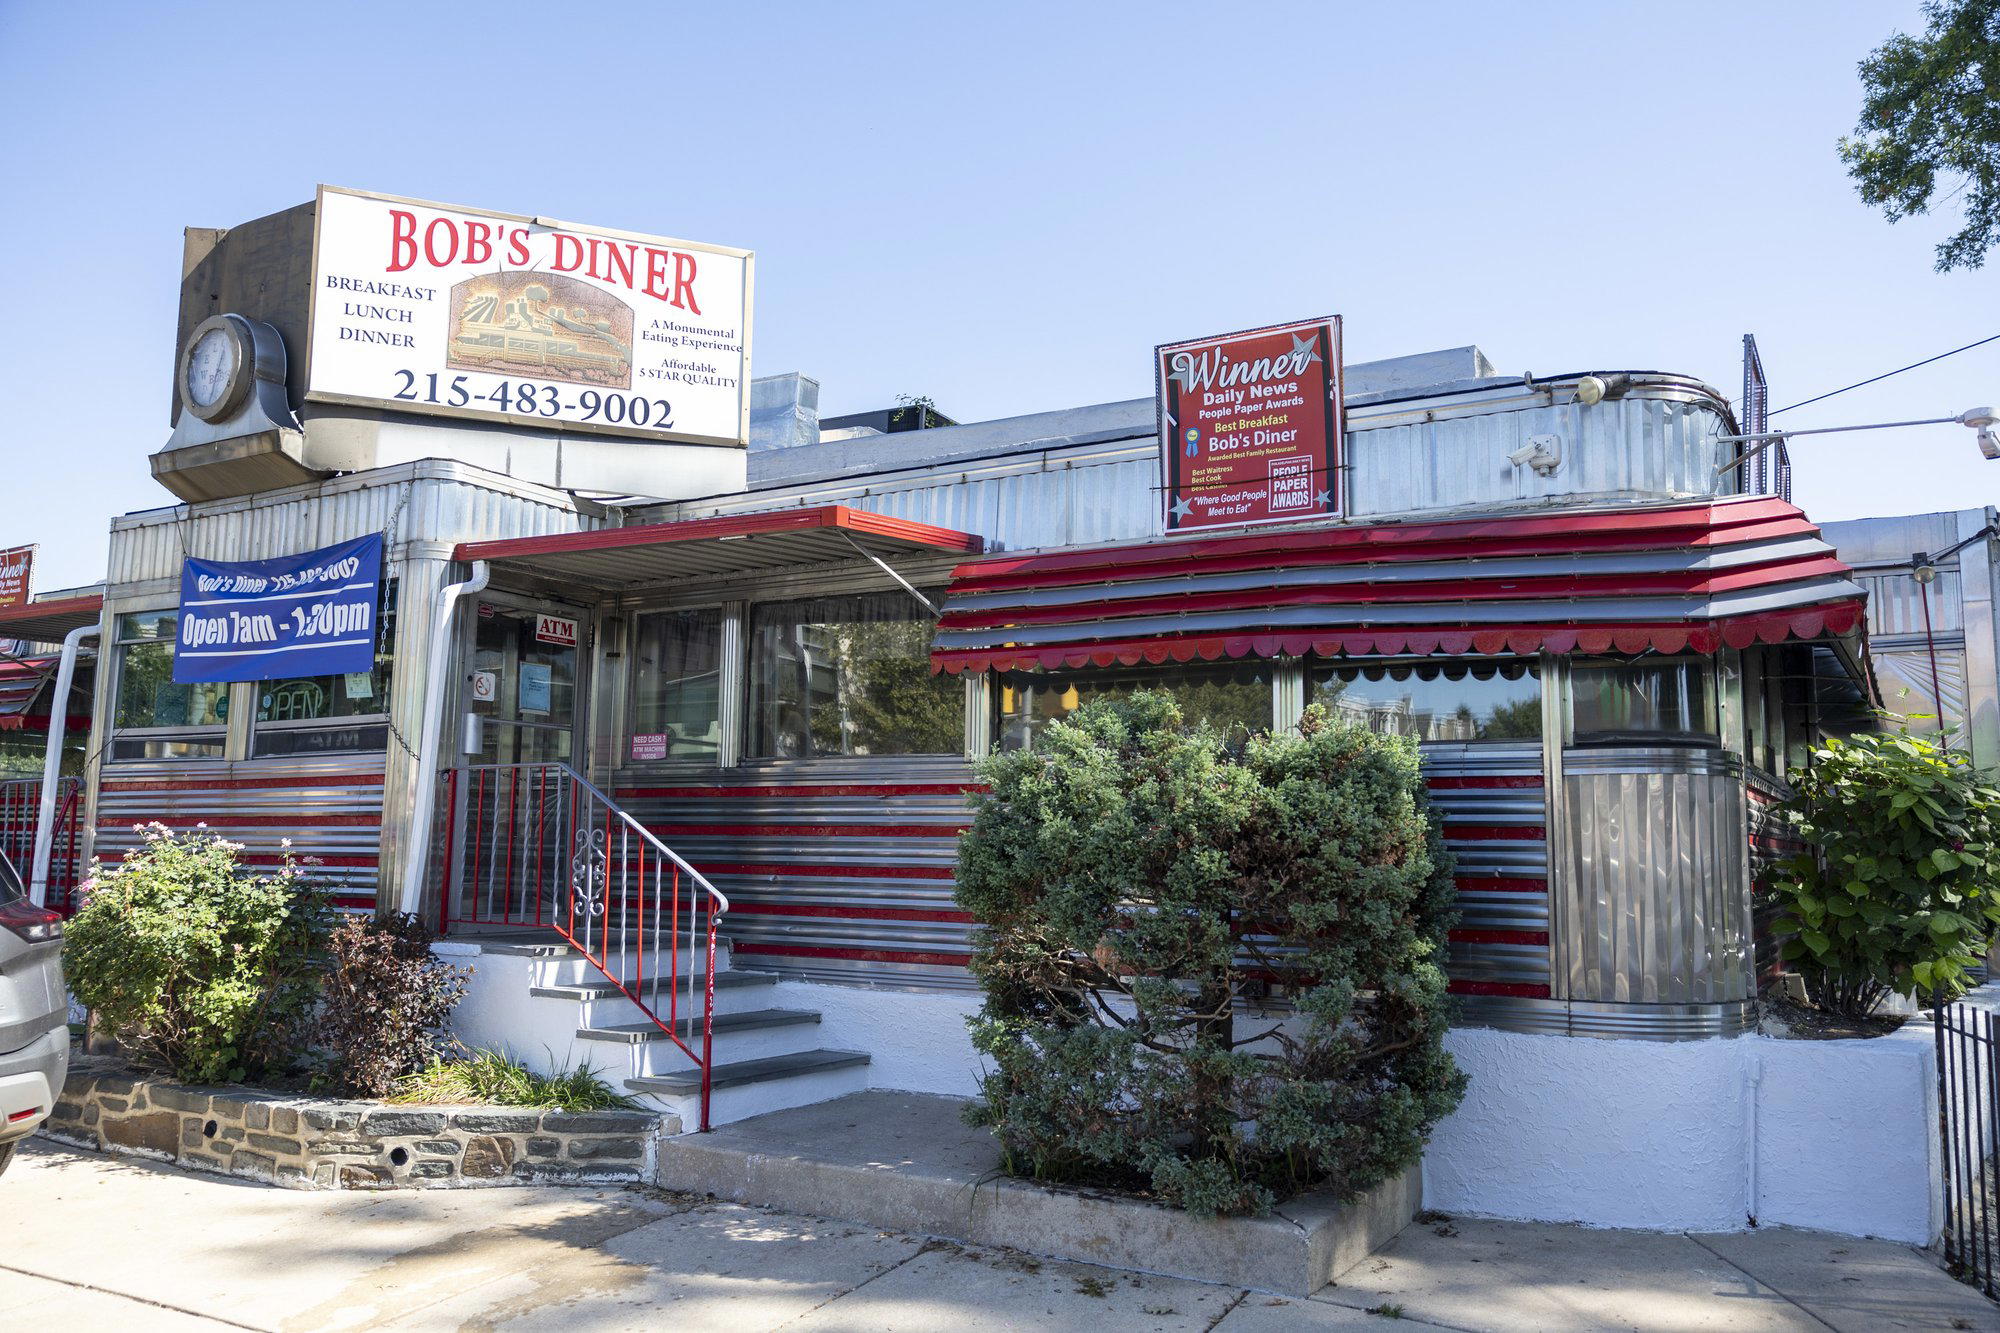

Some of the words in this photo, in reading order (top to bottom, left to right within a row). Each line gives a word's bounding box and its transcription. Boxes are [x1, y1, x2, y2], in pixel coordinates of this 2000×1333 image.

[386, 209, 530, 272] BOB'S
[550, 233, 702, 315] DINER
[326, 275, 436, 301] BREAKFAST
[344, 302, 413, 324] LUNCH
[339, 326, 415, 348] DINNER
[650, 319, 660, 329] A
[662, 320, 735, 339] Monumental
[642, 331, 679, 347] Eating
[681, 335, 743, 353] Experience
[661, 358, 717, 374] Affordable
[1171, 346, 1312, 394] Winner
[639, 367, 646, 377] 5
[648, 369, 680, 381] STAR
[682, 373, 738, 388] QUALITY
[394, 369, 675, 429] 215-483-9002
[1203, 389, 1245, 406] Daily
[1250, 382, 1298, 399] News
[1199, 407, 1232, 420] People
[1234, 403, 1263, 415] Paper
[1265, 396, 1304, 410] Awards
[1215, 421, 1237, 433] Best
[1239, 414, 1288, 430] Breakfast
[1209, 433, 1250, 452] Bob's
[1254, 428, 1298, 446] Diner
[1207, 453, 1233, 462] Awarded
[1246, 449, 1266, 457] Family
[1266, 445, 1297, 456] Restaurant
[1191, 476, 1205, 484] Best
[1205, 474, 1222, 482] Cook
[1206, 466, 1233, 474] Waitress
[1273, 464, 1308, 479] PEOPLE
[1273, 477, 1308, 492] PAPER
[1221, 492, 1242, 503] Good
[1242, 490, 1267, 502] People
[1272, 490, 1309, 508] AWARDS
[1207, 507, 1226, 517] Meet
[1227, 506, 1235, 515] to
[198, 574, 233, 592] Bob's
[230, 574, 268, 593] Diner
[182, 613, 228, 648] Open
[230, 611, 278, 644] 7am
[539, 618, 574, 638] ATM
[633, 735, 648, 743] NEED
[648, 735, 662, 743] CASH
